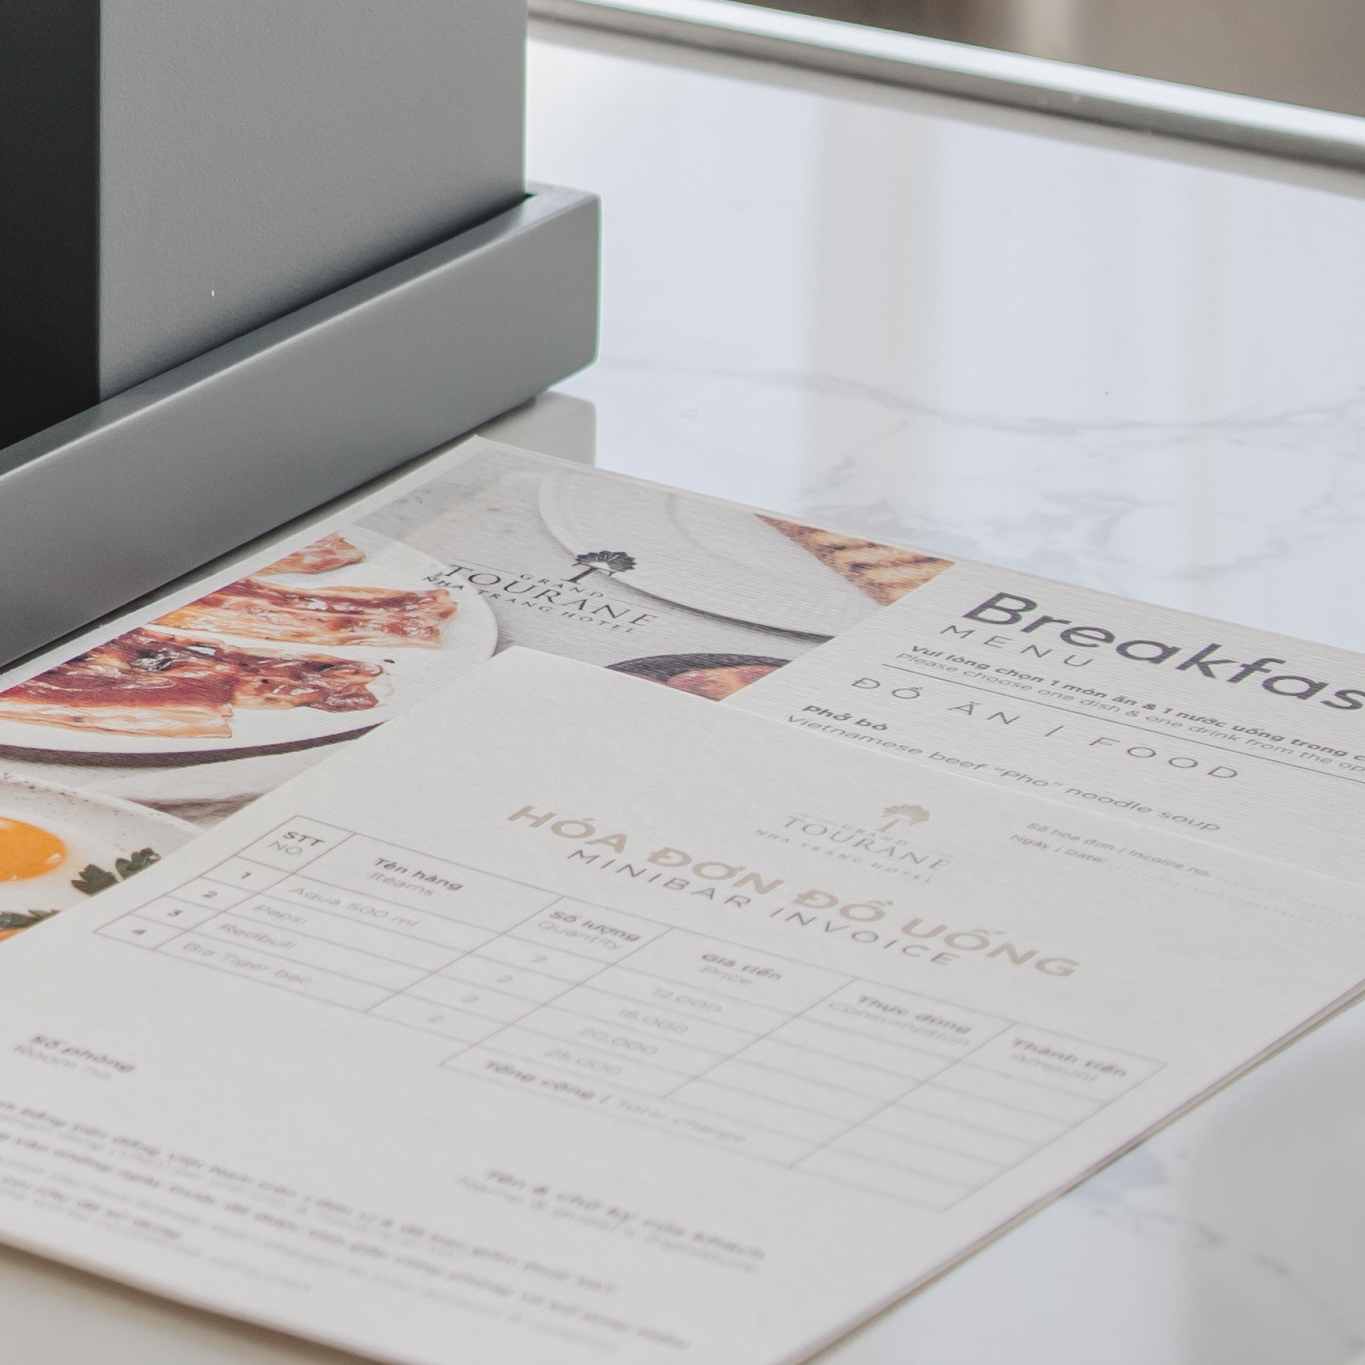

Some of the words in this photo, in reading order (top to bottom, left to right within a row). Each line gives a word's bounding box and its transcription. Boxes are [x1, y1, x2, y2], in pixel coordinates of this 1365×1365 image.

[421, 576, 464, 590] NHA
[477, 589, 553, 613] TRANG
[562, 612, 636, 633] HOTEL
[441, 563, 659, 628] TOURANE
[520, 573, 604, 598] GRAND
[938, 623, 1095, 668] MENU
[896, 653, 958, 672] Please
[963, 671, 1033, 690] choose
[1037, 689, 1075, 701] one
[1079, 700, 1121, 712] dish
[1145, 716, 1183, 727] one
[1188, 726, 1240, 741] drink
[1245, 739, 1294, 755] from
[1299, 752, 1333, 764] the
[912, 645, 943, 657] Vui
[1290, 739, 1348, 757] trong
[948, 701, 1020, 725] ĂN
[1089, 737, 1238, 779] FOOD
[788, 715, 923, 754] Vietnamese
[928, 751, 988, 770] beef
[1066, 788, 1152, 813] noodle
[1159, 812, 1220, 831] soup
[268, 840, 303, 856] NO.
[283, 831, 324, 846] STT
[784, 816, 950, 869] TOURANE
[288, 887, 341, 906] Aqua
[346, 903, 389, 918] 500
[507, 805, 628, 854] HÓA
[646, 847, 784, 895] ĐƠN
[901, 917, 1080, 977] UỐNG
[567, 849, 751, 908] MINIBAR
[770, 908, 959, 965] INVOICE
[537, 920, 623, 950] Quantity
